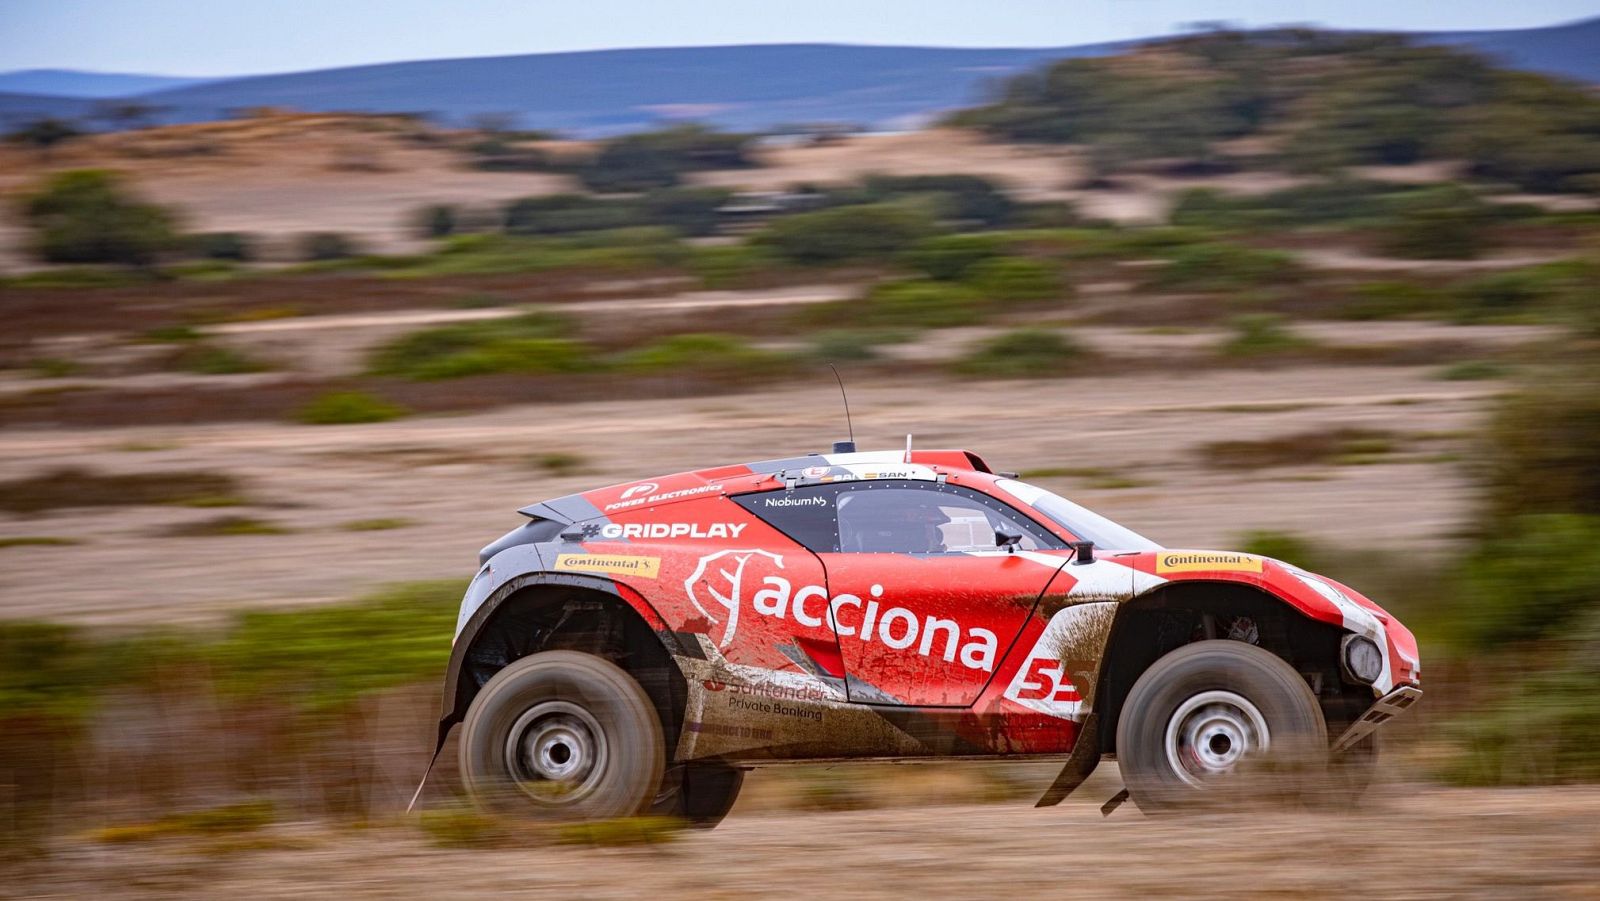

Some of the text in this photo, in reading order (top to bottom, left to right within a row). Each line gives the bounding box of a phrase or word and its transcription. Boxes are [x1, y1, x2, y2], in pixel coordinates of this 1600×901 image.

[605, 484, 724, 511] POWER ELECTRONICS
[765, 497, 811, 507] Niobium
[563, 556, 639, 569] Continental
[1163, 554, 1241, 567] Continental
[753, 575, 998, 672] acciona
[729, 677, 826, 701] Santander
[1017, 657, 1098, 702] 55
[728, 697, 823, 721] Private Banking
